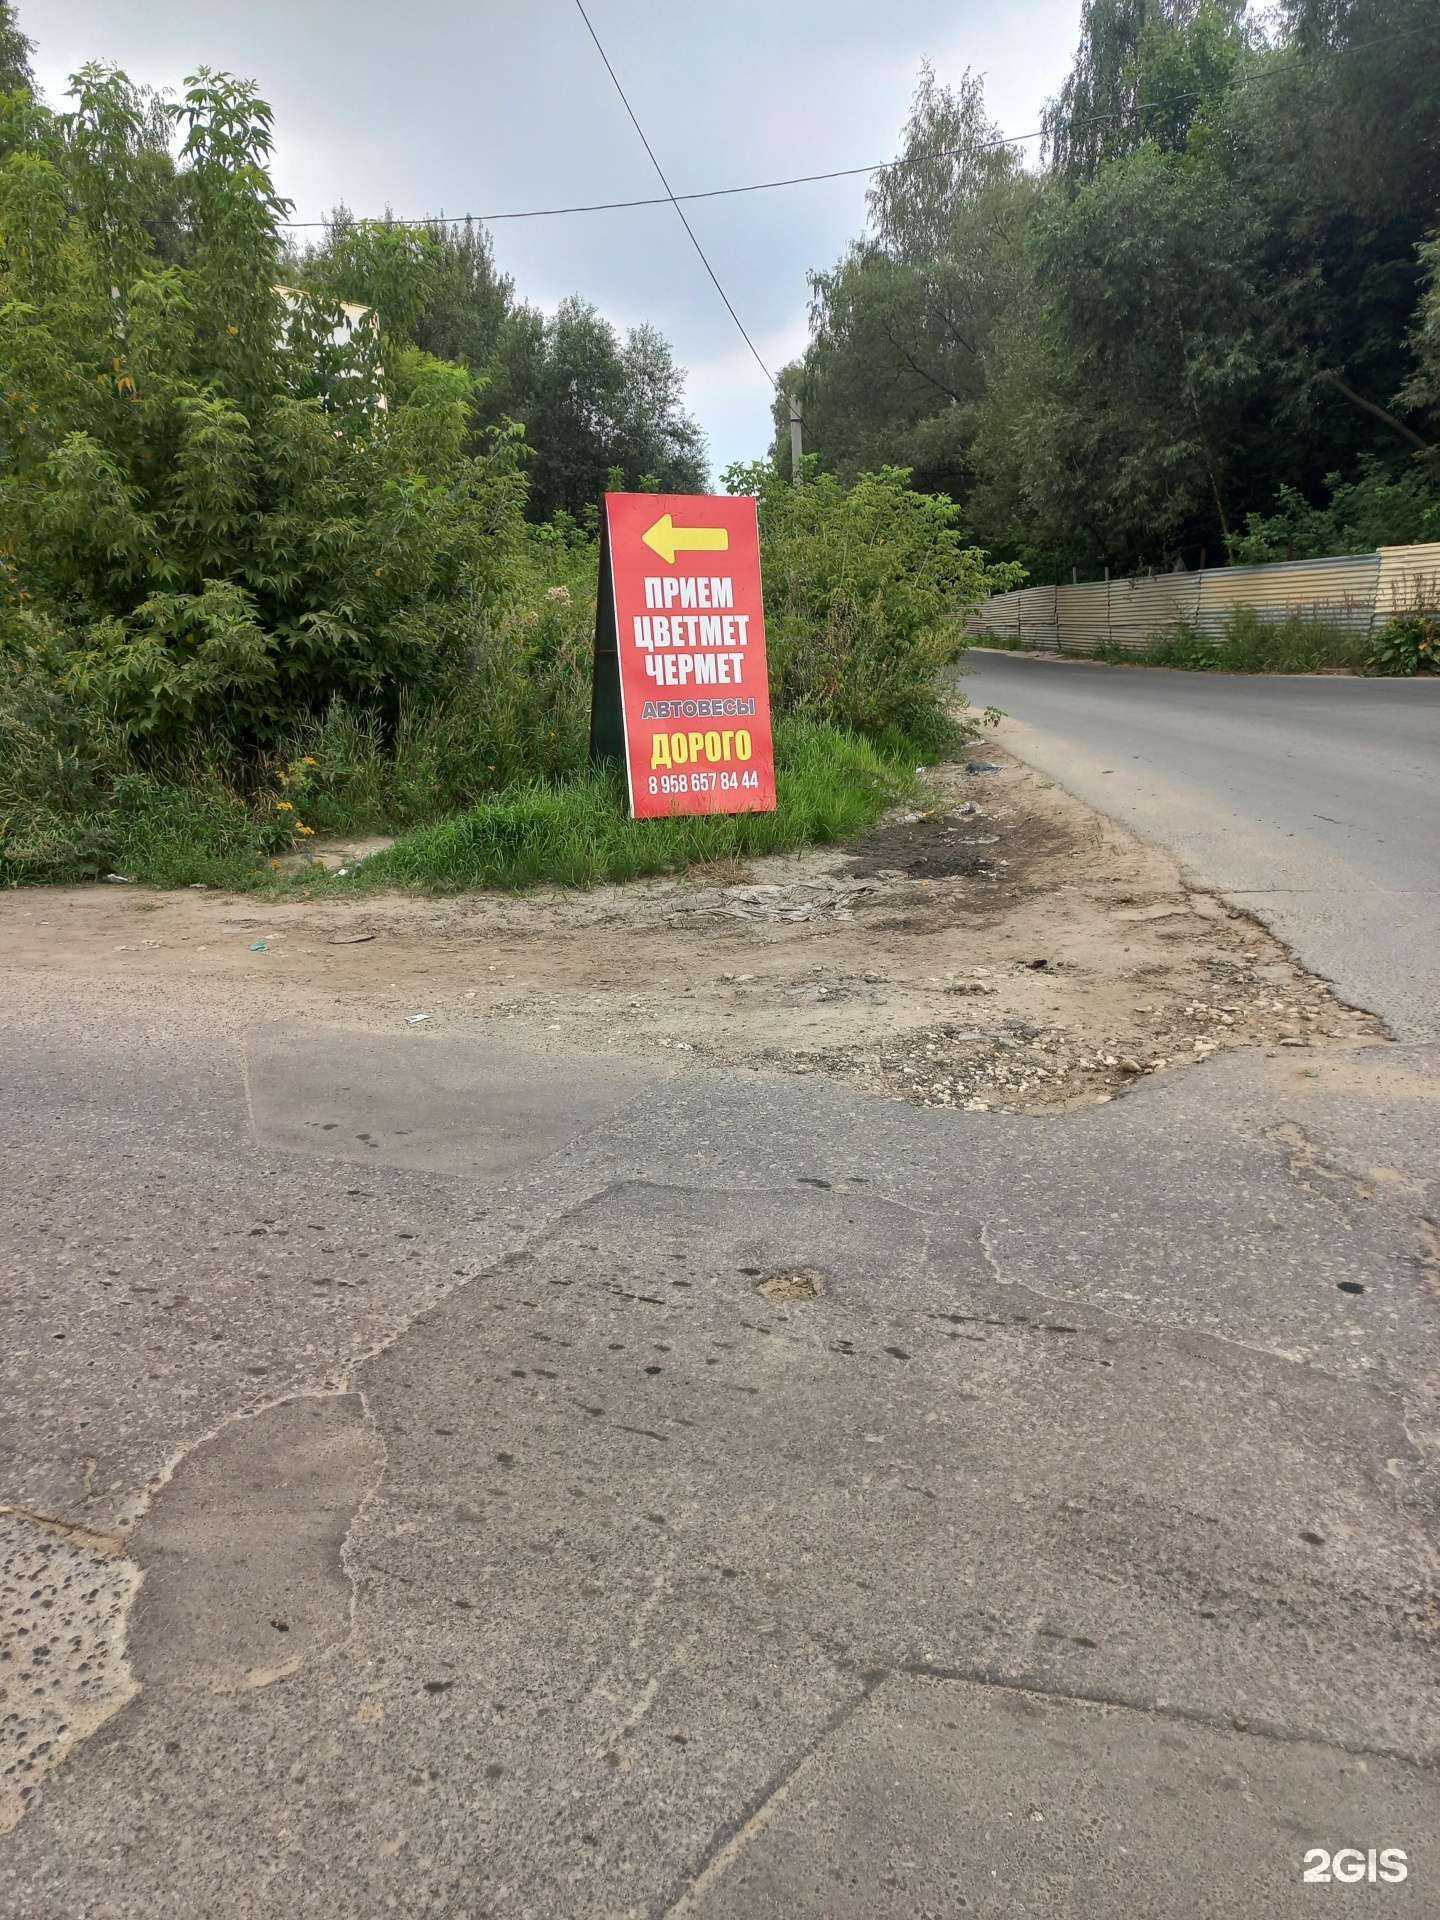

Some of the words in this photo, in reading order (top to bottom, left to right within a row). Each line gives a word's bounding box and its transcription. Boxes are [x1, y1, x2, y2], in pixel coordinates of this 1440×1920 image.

[644, 576, 733, 609] ПРИЕМ
[633, 615, 749, 652] ЦВЕТМЕТ
[644, 652, 744, 685] ЧЕРМЕТ
[642, 697, 756, 720] АВТОВЕСЫ
[650, 729, 752, 770] ДОРОГО
[648, 775, 658, 795] 8
[660, 774, 688, 794] 958
[690, 772, 717, 792] 657
[720, 771, 739, 790] 84
[741, 770, 759, 789] 44
